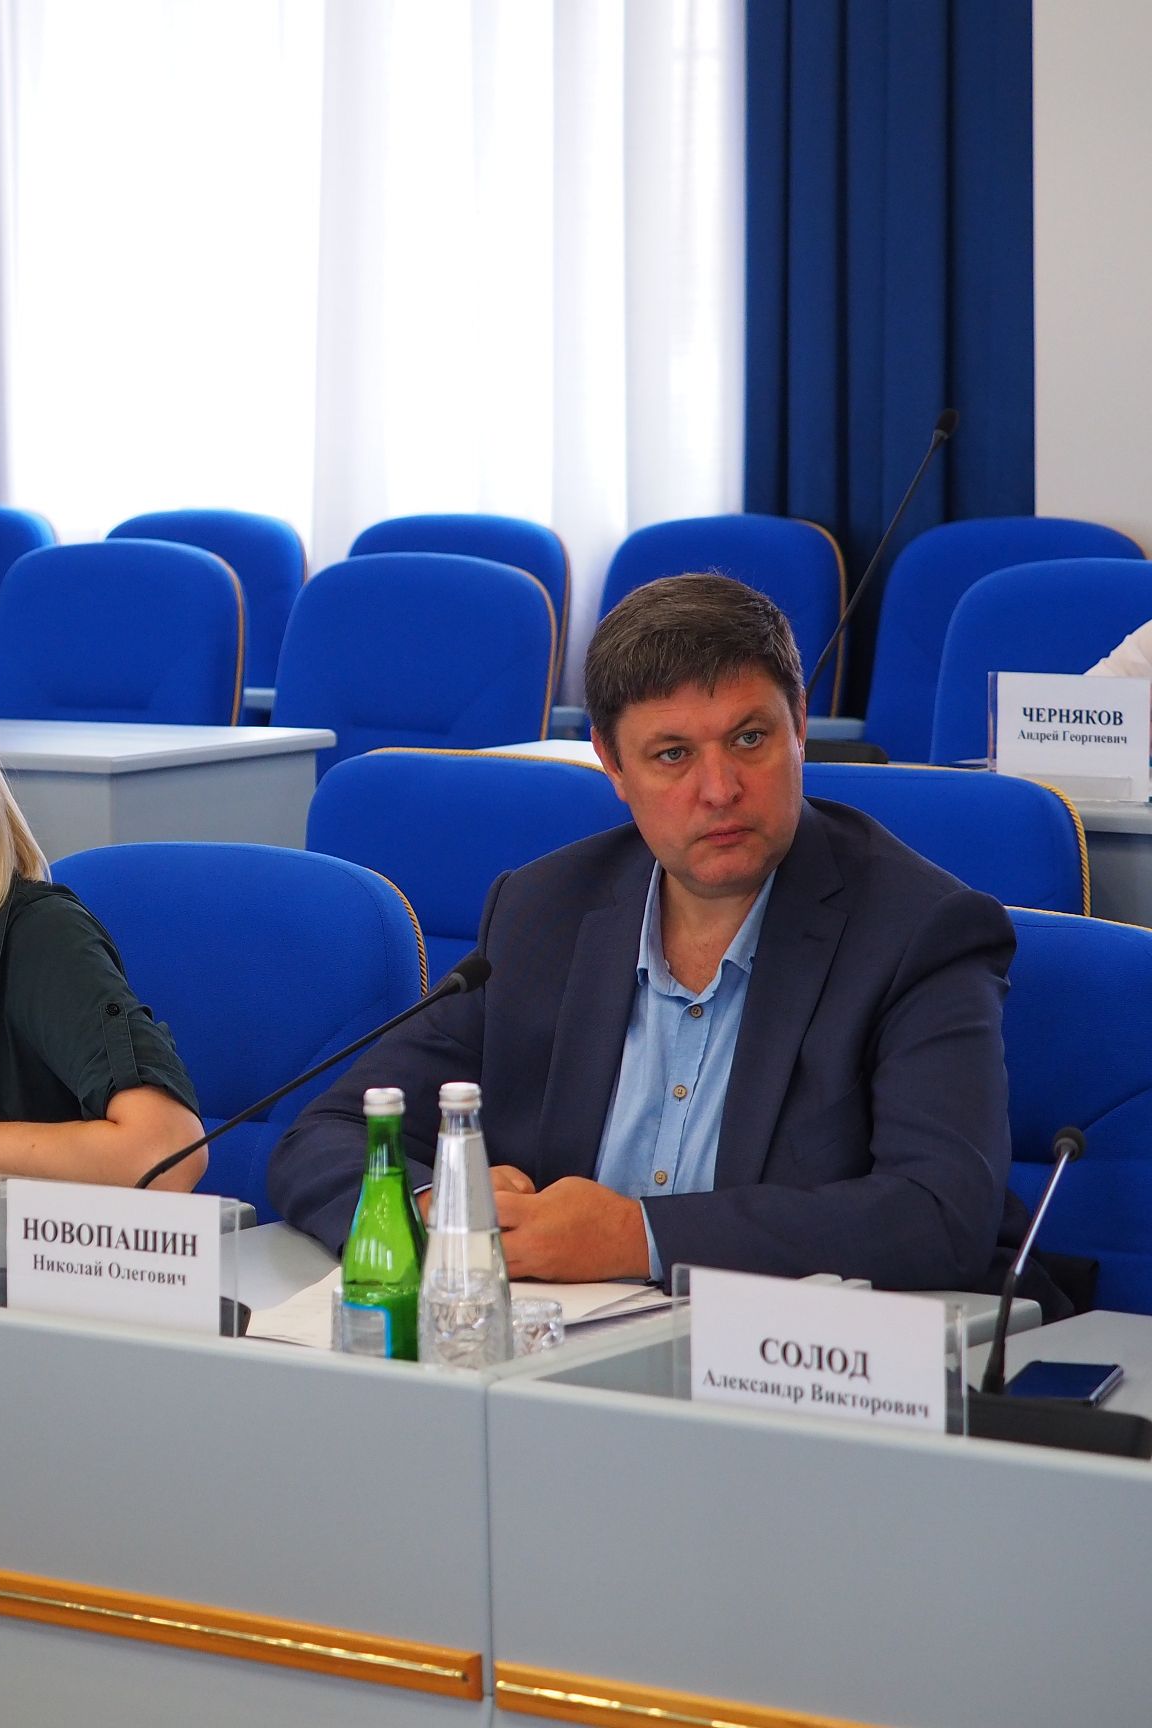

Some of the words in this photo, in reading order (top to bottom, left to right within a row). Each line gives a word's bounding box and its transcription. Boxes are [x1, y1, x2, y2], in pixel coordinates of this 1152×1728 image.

[1022, 707, 1124, 726] ЧЕРНЯКОВ
[1017, 729, 1059, 743] Андрей
[1062, 730, 1128, 745] Георгиевич
[23, 1217, 197, 1257] НОВОПАШИН
[33, 1254, 103, 1277] Николай
[108, 1262, 186, 1286] Олегович
[759, 1337, 870, 1383] СОЛОД
[702, 1369, 804, 1404] Александр
[811, 1383, 929, 1418] Викторович
